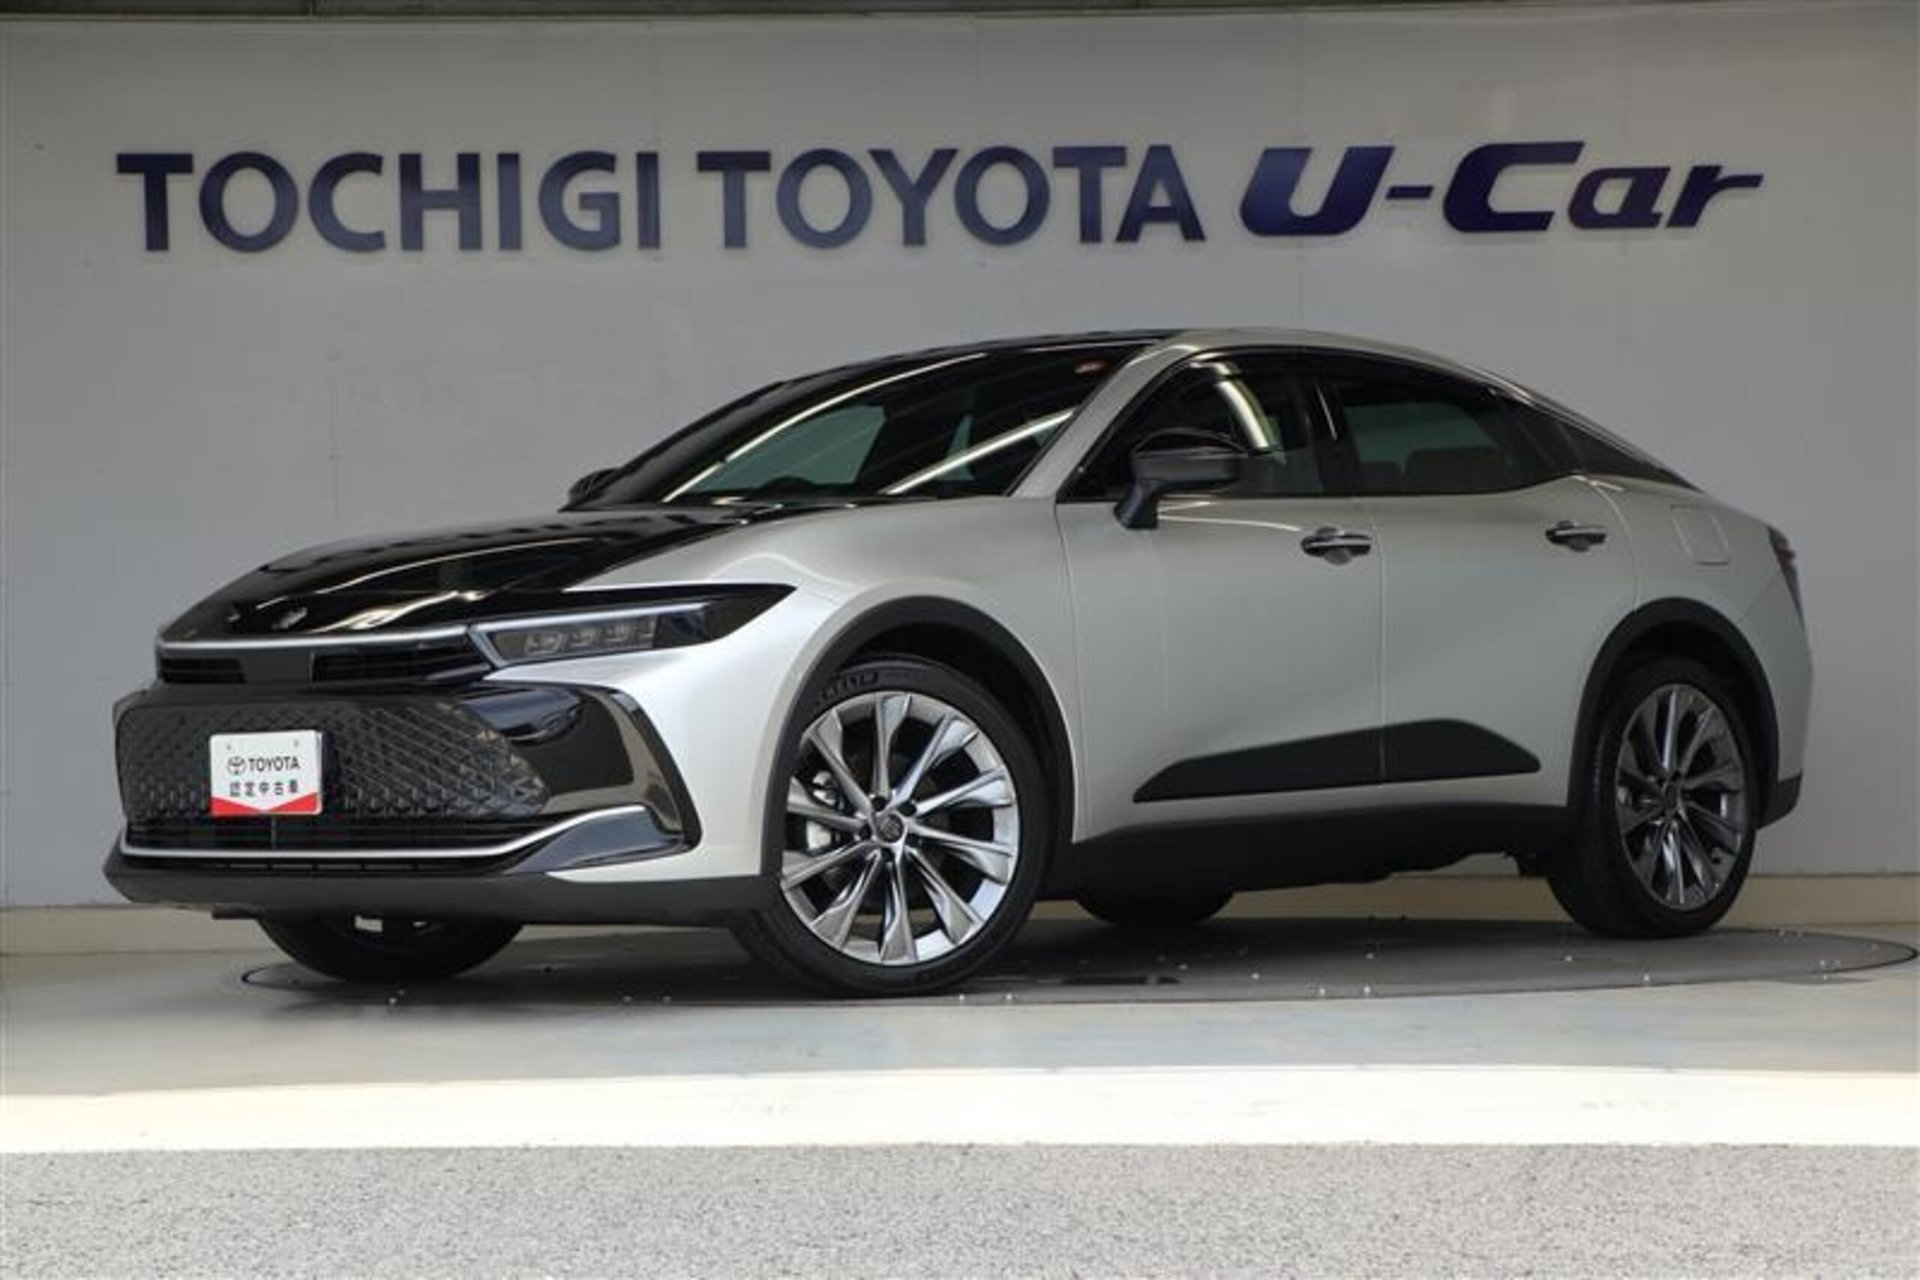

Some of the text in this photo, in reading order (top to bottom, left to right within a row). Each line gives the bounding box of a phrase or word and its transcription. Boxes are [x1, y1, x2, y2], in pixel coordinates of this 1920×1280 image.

[115, 139, 1764, 254] TOCHIGI TOYOTA U-Car
[249, 756, 300, 772] TOYOTA
